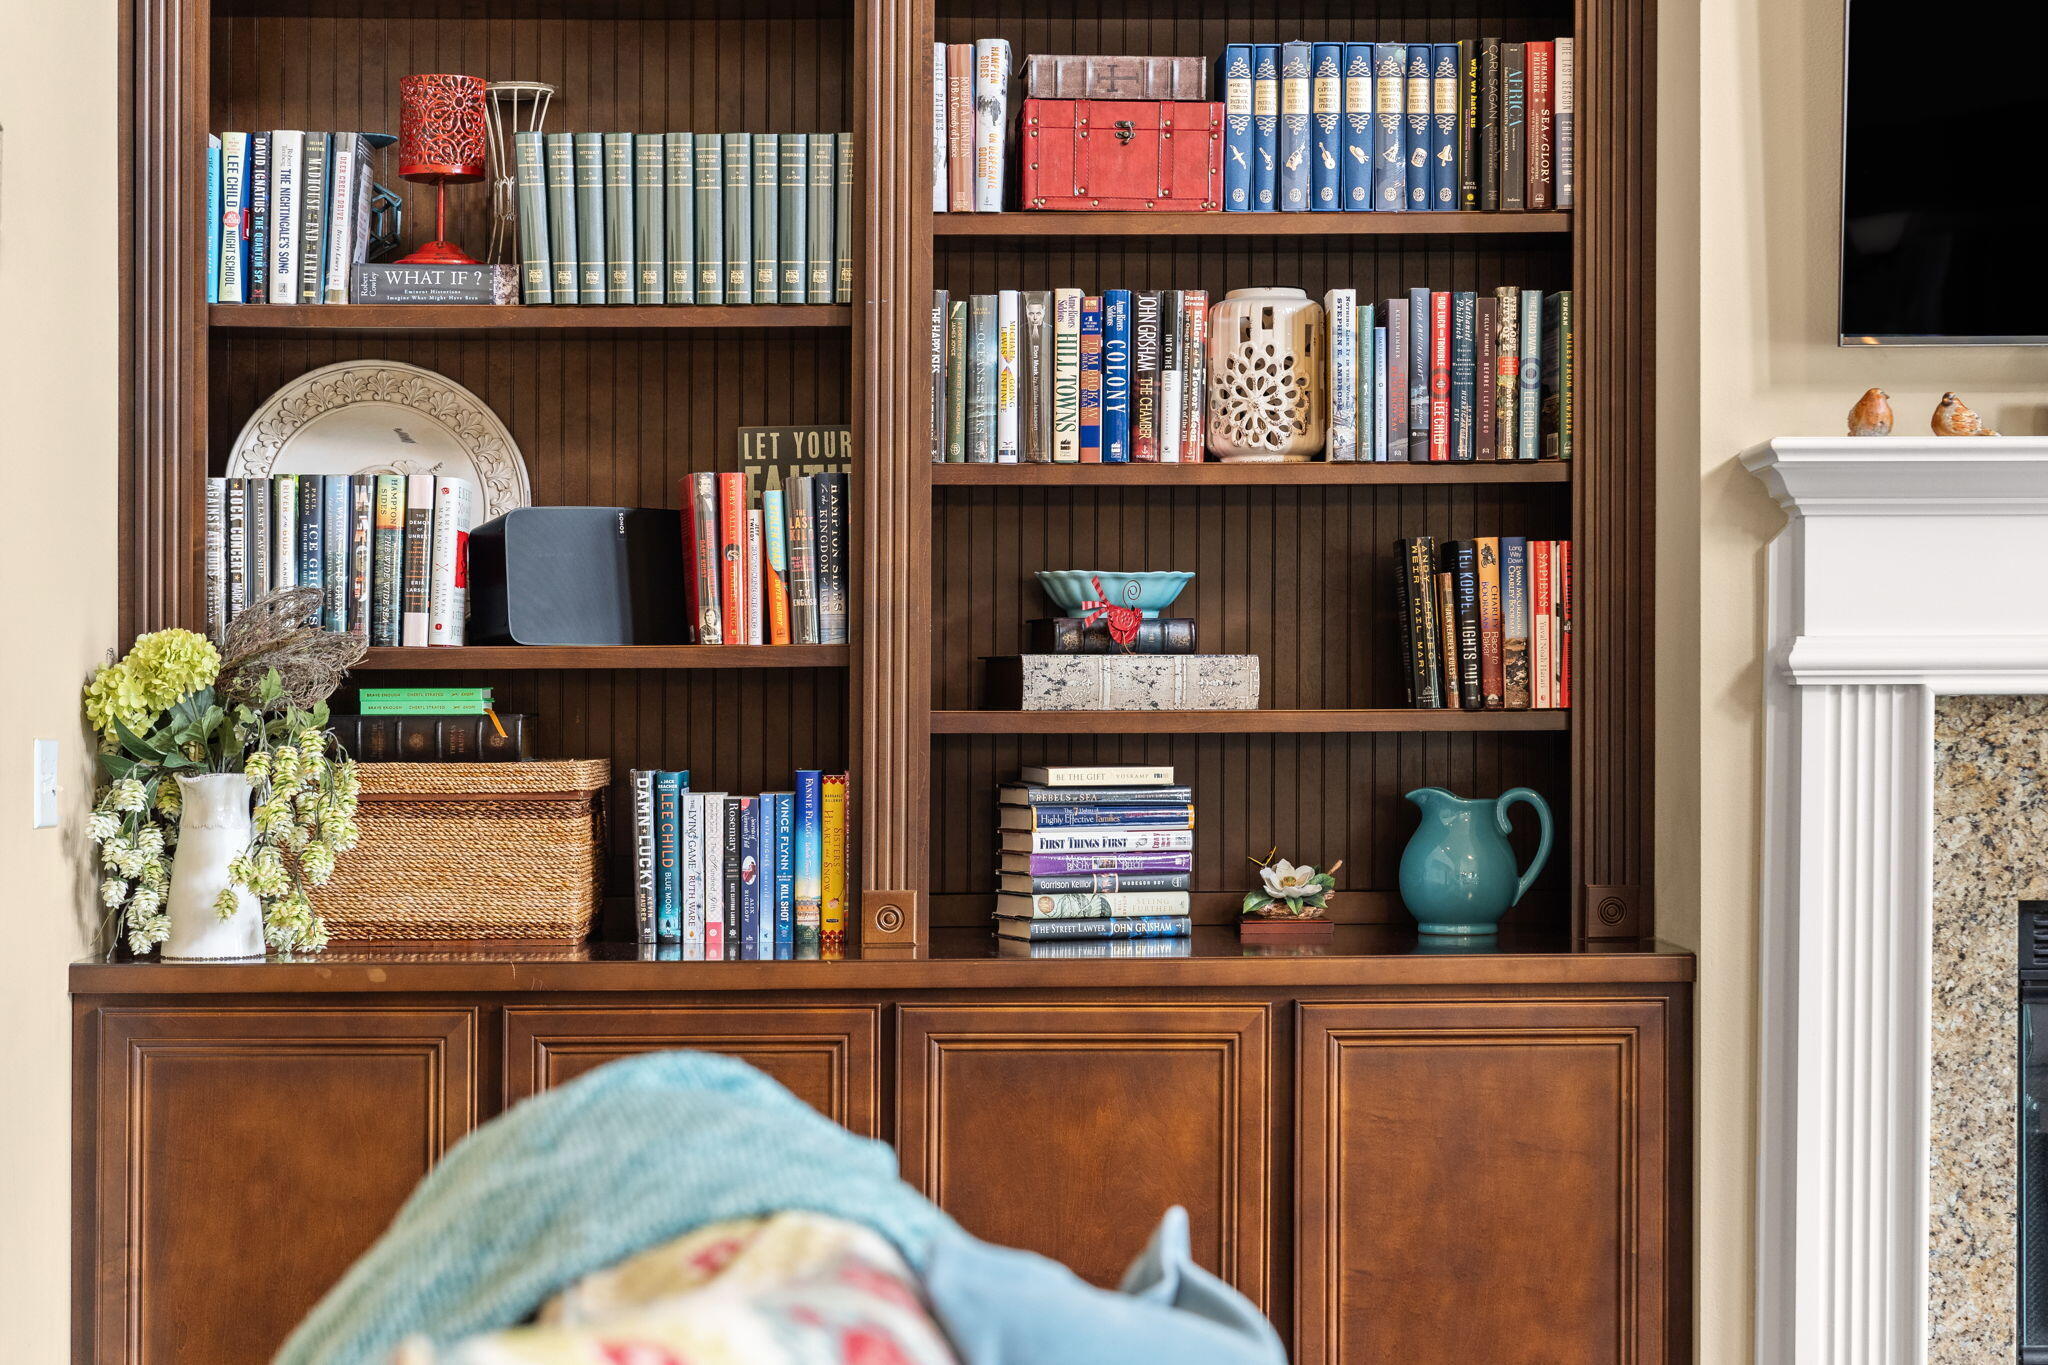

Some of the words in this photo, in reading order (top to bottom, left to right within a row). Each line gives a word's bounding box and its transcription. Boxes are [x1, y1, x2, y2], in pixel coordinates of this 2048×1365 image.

[980, 55, 989, 78] SIDES
[990, 46, 999, 84] HAMPTON
[1469, 59, 1477, 78] why
[1489, 44, 1498, 76] CARL
[1470, 80, 1477, 93] we
[1489, 78, 1498, 119] SAGAN
[1509, 70, 1523, 126] AFRICA
[1471, 118, 1477, 128] us
[227, 155, 238, 173] LEE
[254, 137, 266, 165] DAVID
[978, 147, 988, 178] GROUND
[1541, 143, 1549, 184] GLORY
[280, 169, 291, 184] THE
[307, 158, 321, 210] MADHOUSE
[226, 177, 238, 207] CHILD
[254, 170, 266, 213] IGNATIUS
[255, 216, 264, 230] THE
[279, 187, 291, 248] NIGHTINGALE'S
[336, 200, 344, 220] DRIVE
[226, 230, 236, 253] NIGHT
[305, 222, 319, 241] END
[254, 233, 264, 267] QUANTUM
[278, 251, 289, 274] SONG
[225, 255, 235, 287] SCHOOL
[254, 270, 263, 284] SPY
[303, 253, 318, 284] EARTH
[385, 271, 444, 284] WHAT
[451, 271, 468, 284] IF
[474, 271, 482, 285] ?
[369, 272, 379, 296] Cowley
[1138, 295, 1157, 322] JOHN
[1438, 296, 1446, 310] BAD
[1194, 310, 1202, 348] Killers
[1438, 311, 1446, 328] LUCK
[1456, 300, 1464, 340] Philbrick
[1465, 298, 1473, 341] Nathaniel
[1528, 311, 1537, 334] HARD
[1137, 325, 1156, 371] GRISHAM
[1503, 327, 1509, 341] OF
[1528, 336, 1537, 356] WAY
[977, 333, 985, 383] OCEANS
[1057, 333, 1077, 371] HILL
[1088, 340, 1098, 364] TOM
[1437, 338, 1446, 366] TROUBLE
[1106, 340, 1126, 413] COLONY
[1140, 378, 1152, 395] THE
[1191, 368, 1201, 409] Flower
[1055, 375, 1076, 432] TOWNS
[1088, 370, 1098, 419] BROKAW
[1434, 401, 1445, 415] LEE
[1524, 392, 1535, 408] LEE
[976, 396, 984, 433] STARS
[1139, 397, 1152, 439] CHAMBER
[1190, 410, 1198, 441] Moon
[1523, 411, 1534, 438] CHILD
[1433, 418, 1445, 444] CHILD
[1483, 425, 1489, 433] GO
[744, 432, 779, 459] LET
[793, 431, 851, 459] YOUR
[230, 490, 244, 521] ROCK
[231, 527, 244, 574] CONCERT
[309, 523, 318, 551] ICE
[1411, 545, 1420, 583] WEIR
[1421, 545, 1430, 583] ANDY
[1459, 548, 1473, 569] TED
[1460, 572, 1474, 615] KOPPEL
[1540, 553, 1548, 607] SAPIENS
[1414, 598, 1422, 633] HAIL
[1462, 620, 1476, 659] LIGHTS
[1482, 631, 1491, 658] Dakar
[1491, 631, 1499, 654] Race
[1417, 642, 1425, 676] MARY
[1491, 656, 1499, 664] to
[1463, 663, 1478, 685] OUT
[637, 778, 650, 826] DAMN
[661, 793, 673, 819] LEE
[781, 799, 789, 833] VINCE
[688, 810, 697, 837] LYING
[727, 802, 738, 852] Rosemary
[805, 810, 813, 837] FLAGG
[824, 810, 833, 845] HEART
[1041, 816, 1062, 825] Highly
[1063, 816, 1094, 824] Effective
[662, 823, 674, 868] CHILD
[688, 840, 696, 869] GAME
[781, 836, 789, 870] FLYNN
[1040, 838, 1065, 849] FIRST
[1068, 838, 1100, 848] THINGS
[1102, 837, 1128, 847] FIRST
[639, 835, 652, 890] LUCKY
[823, 862, 833, 892] SNOW
[781, 884, 789, 899] KILL
[781, 901, 789, 921] SHOT
[1051, 925, 1077, 933] STREET
[1078, 924, 1106, 932] LAWYER
[1111, 923, 1132, 932] JOHN
[1135, 920, 1172, 931] GRISHAM
